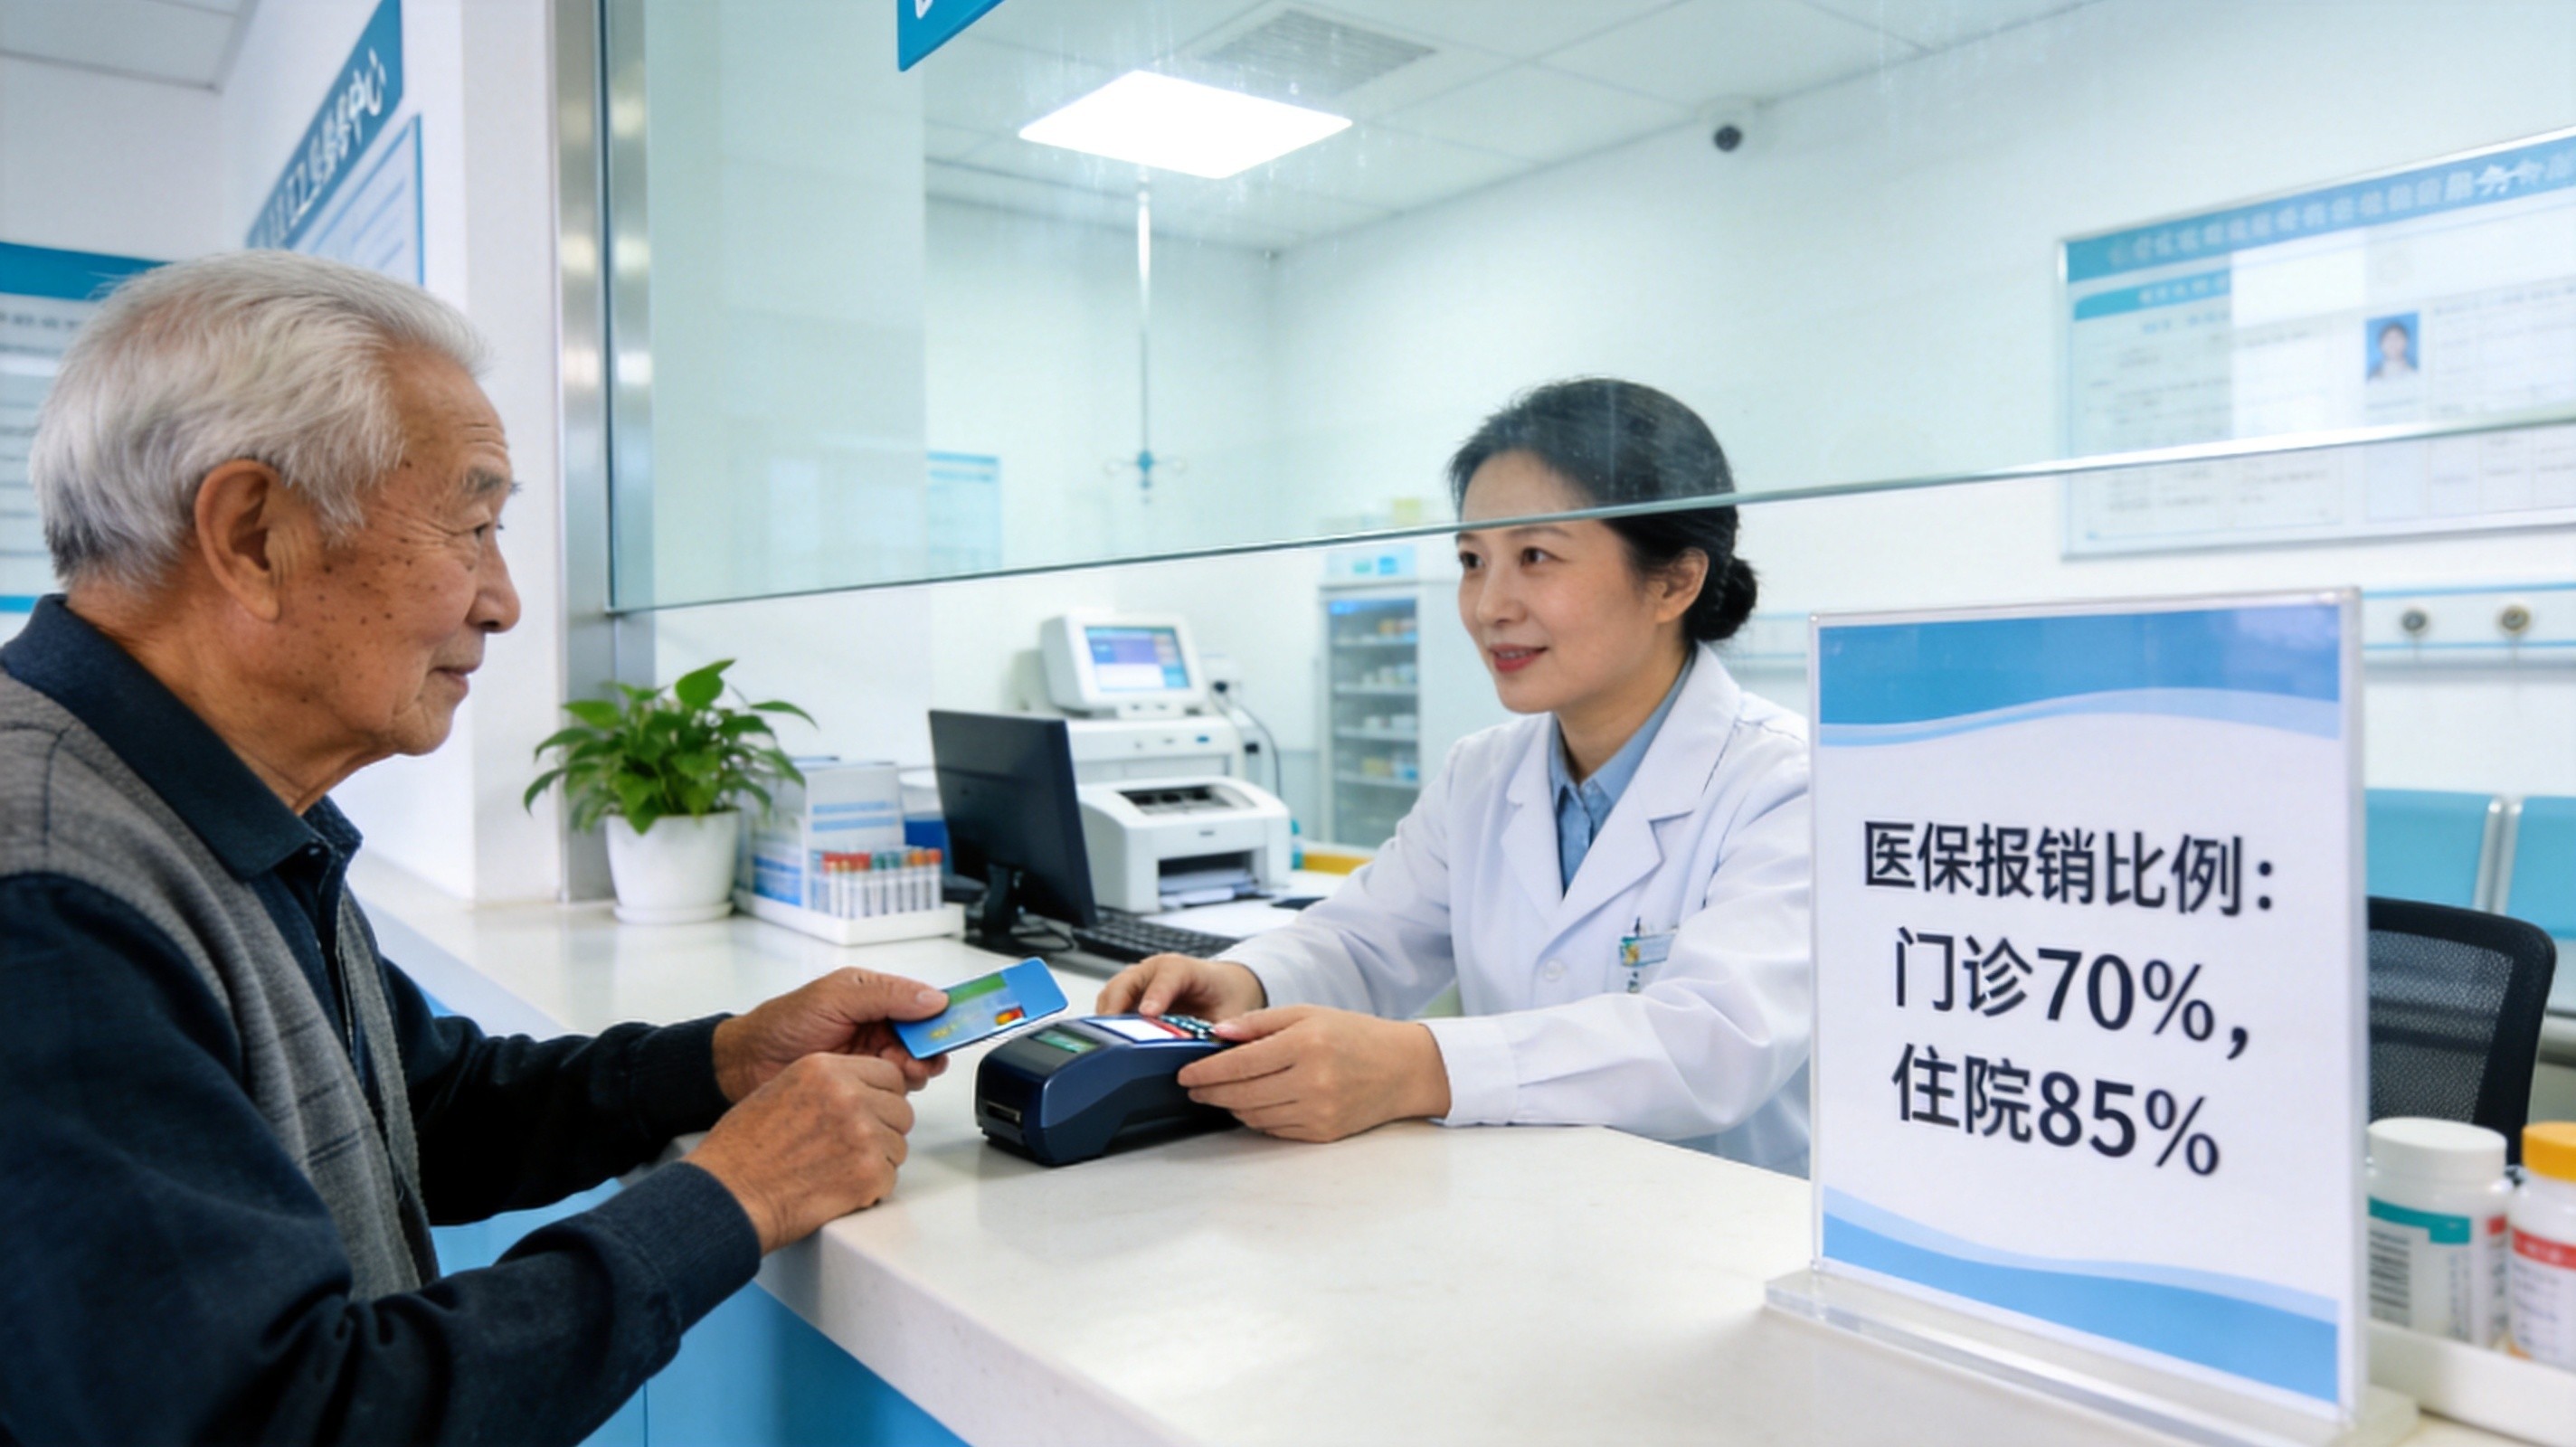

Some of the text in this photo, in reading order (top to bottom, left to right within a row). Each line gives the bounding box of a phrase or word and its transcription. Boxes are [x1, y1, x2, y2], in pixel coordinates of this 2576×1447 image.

[1864, 821, 2273, 917] 医保报销比例：
[1896, 926, 2249, 1060] 门诊70%，
[1892, 1043, 2220, 1176] 住院85%
